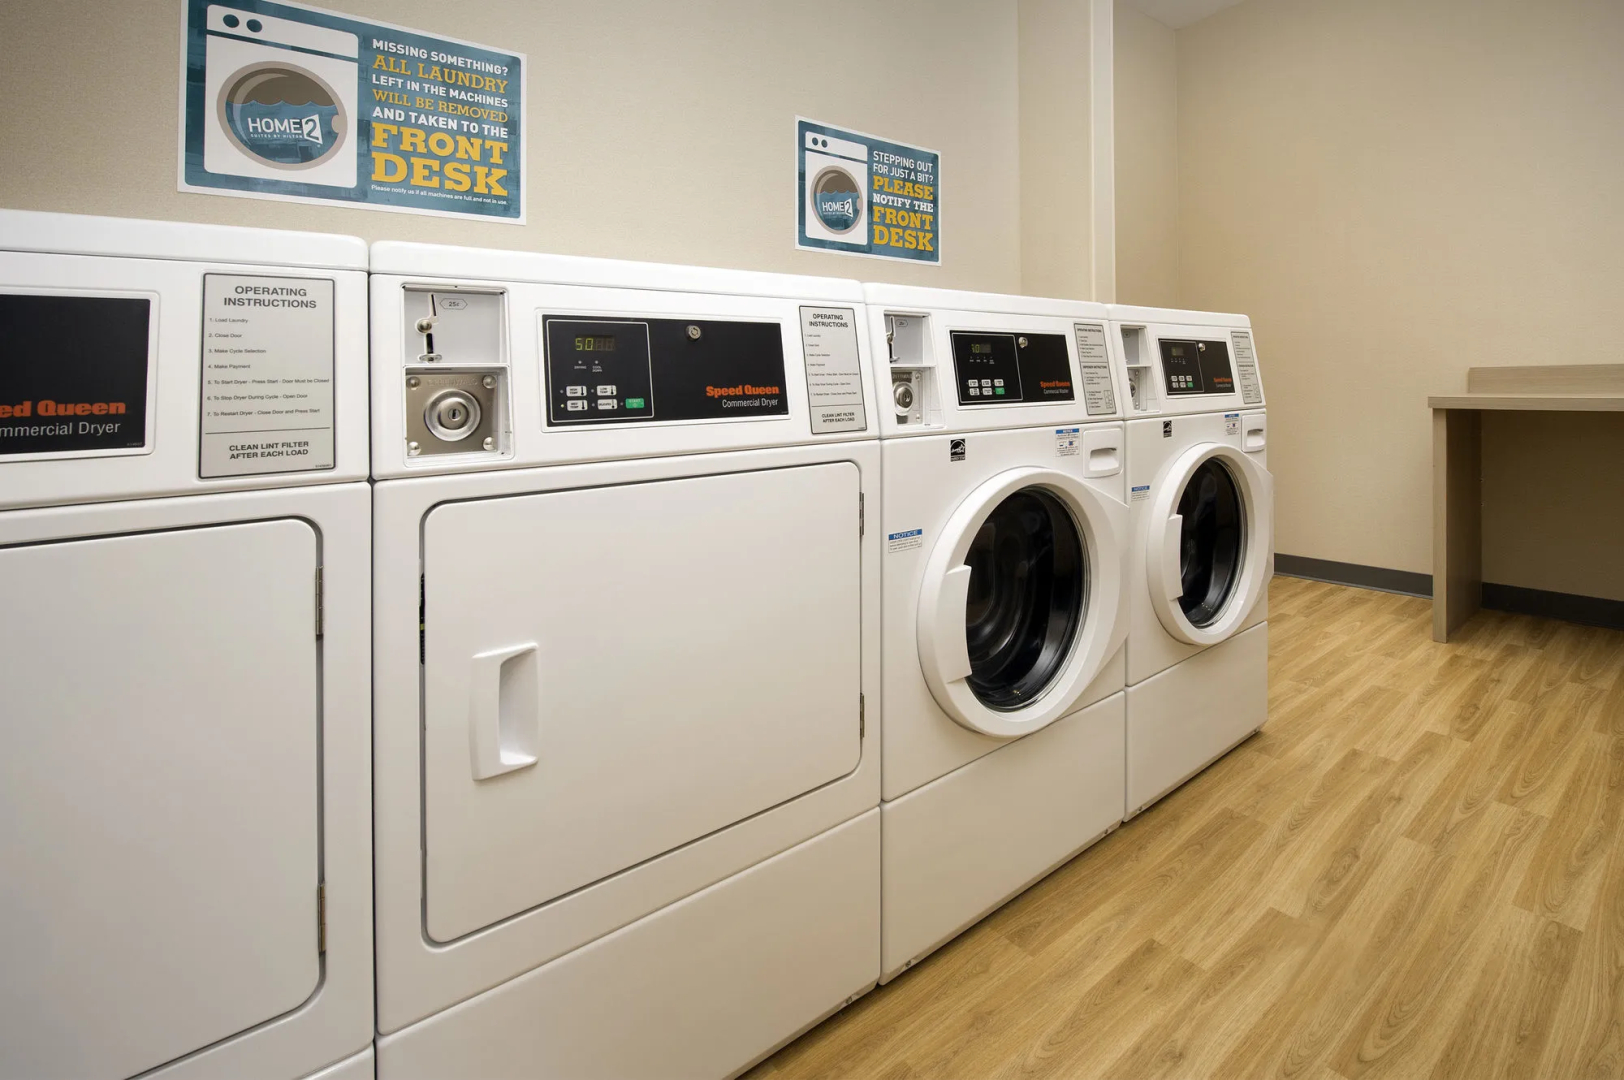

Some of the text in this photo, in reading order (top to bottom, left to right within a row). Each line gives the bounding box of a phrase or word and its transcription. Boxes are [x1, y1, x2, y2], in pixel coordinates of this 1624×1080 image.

[373, 39, 508, 76] MISSING SOMETHING?
[373, 55, 508, 93] ALL LAUNDRY
[372, 74, 508, 108] LEFT IN THE MACHINES
[373, 89, 508, 123] WILL BE REMOVED
[372, 106, 508, 138] AND TAKEN TO THE
[372, 122, 508, 164] FRONT
[873, 151, 933, 172] STEPPING OUT
[873, 163, 933, 183] FOR JUST A BIT?
[372, 152, 508, 196] DESK
[873, 175, 933, 200] PLEASE
[873, 193, 933, 212] NOTIFY THE
[873, 206, 933, 230] FRONT
[873, 225, 933, 251] DESK
[224, 298, 316, 308] INSTRUCTIONS
[235, 286, 307, 296] OPERATING
[706, 385, 779, 398] Speed Queen
[722, 398, 778, 408] Commercial Dryer
[37, 400, 126, 416] Queen
[79, 422, 120, 436] Dryer
